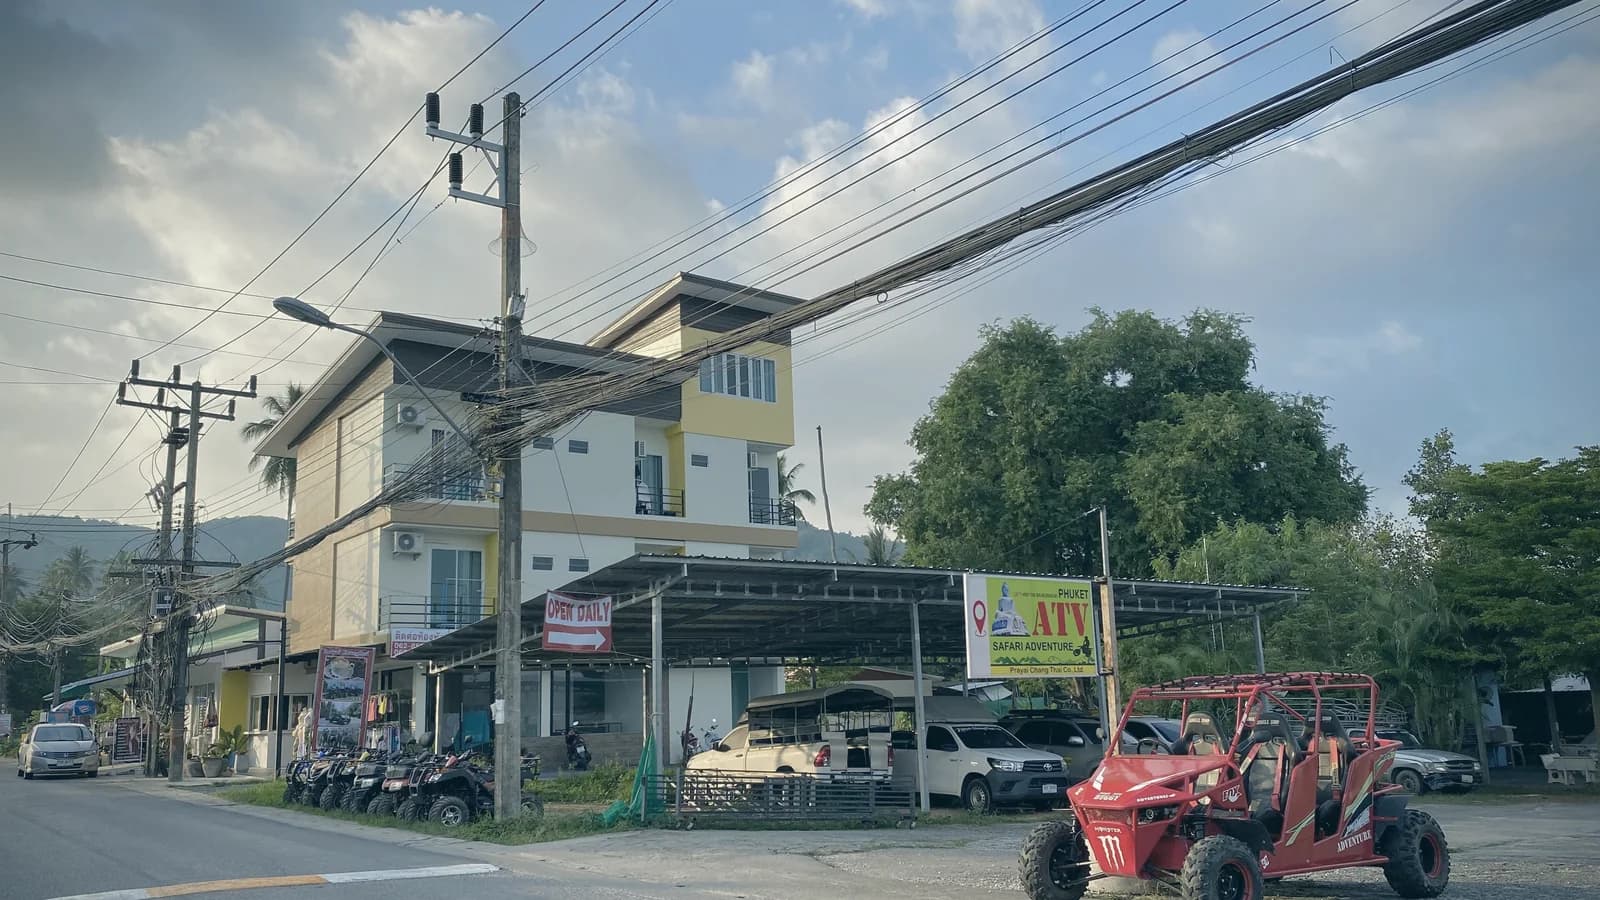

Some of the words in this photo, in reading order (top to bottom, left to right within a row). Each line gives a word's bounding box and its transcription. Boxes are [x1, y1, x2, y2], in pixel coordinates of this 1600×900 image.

[1058, 588, 1088, 599] PHUKET
[547, 598, 573, 621] OPEN
[577, 601, 610, 622] DAILY
[1032, 601, 1089, 636] ATV
[992, 641, 1024, 651] SAFARI
[1025, 641, 1074, 652] ADVENTURE
[1050, 666, 1062, 674] Thai
[1222, 784, 1242, 803] FOX
[1337, 830, 1373, 853] ADVENTURE
